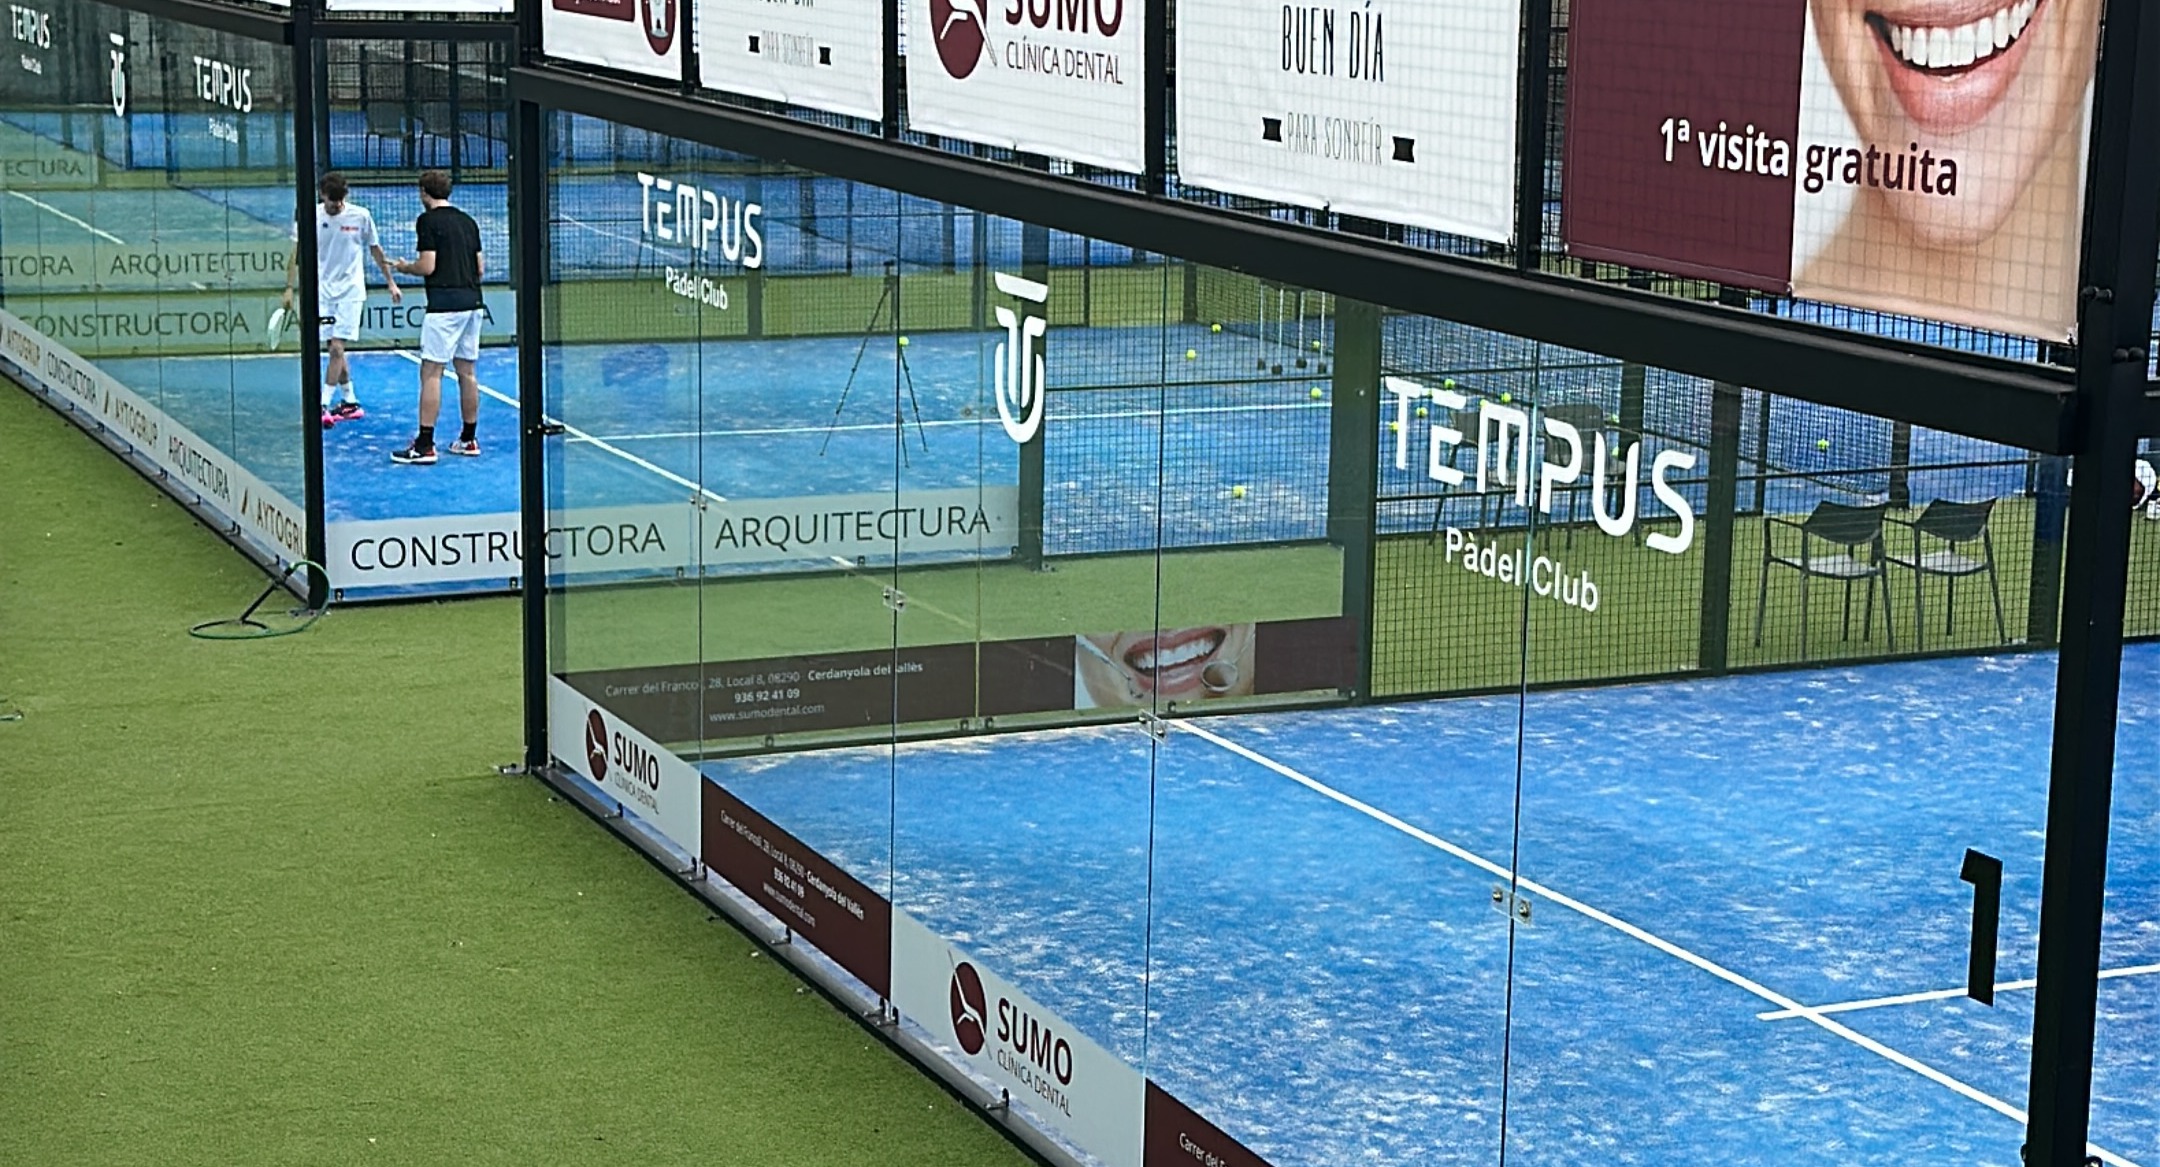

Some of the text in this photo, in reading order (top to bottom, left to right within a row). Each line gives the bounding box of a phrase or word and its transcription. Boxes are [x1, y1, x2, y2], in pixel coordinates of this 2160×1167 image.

[9, 4, 50, 49] TEMPUS
[1281, 0, 1384, 82] BUEN DÍA
[193, 56, 252, 113] TEMPUS
[1005, 35, 1123, 85] CLÍNICA DENTAL
[1287, 111, 1382, 165] PARA SONREÍR
[1698, 121, 1790, 177] visita
[1803, 142, 1957, 196] gratuita
[0, 159, 84, 177] ECTURA
[637, 171, 762, 269] TEMPUS
[110, 251, 291, 278] ARQUITECTUR
[665, 265, 728, 310] Pàdel Club
[19, 310, 250, 339] ONSTRUCTORA
[1386, 375, 1696, 555] TEMPUS
[168, 434, 231, 503] ARQUITECTURA
[256, 497, 307, 560] AYTOGRU
[715, 503, 990, 552] ARQUITECTURA
[1445, 526, 1599, 612] Pàdel Club
[605, 684, 639, 697] Carrer
[642, 682, 660, 694] del
[727, 675, 754, 687] Local
[807, 665, 871, 681] Cerdanyola
[873, 663, 891, 675] del
[892, 662, 924, 674] allès
[734, 691, 753, 704] 936
[756, 690, 769, 701] 92
[771, 689, 784, 700] 41
[709, 703, 825, 722] www.sumodental.com
[614, 731, 659, 790] SUMO
[1960, 847, 2003, 1008] 1
[997, 997, 1073, 1086] SUMO
[997, 1048, 1073, 1118] CLÍNICA DENTAL
[1179, 1132, 1206, 1161] Carrer
